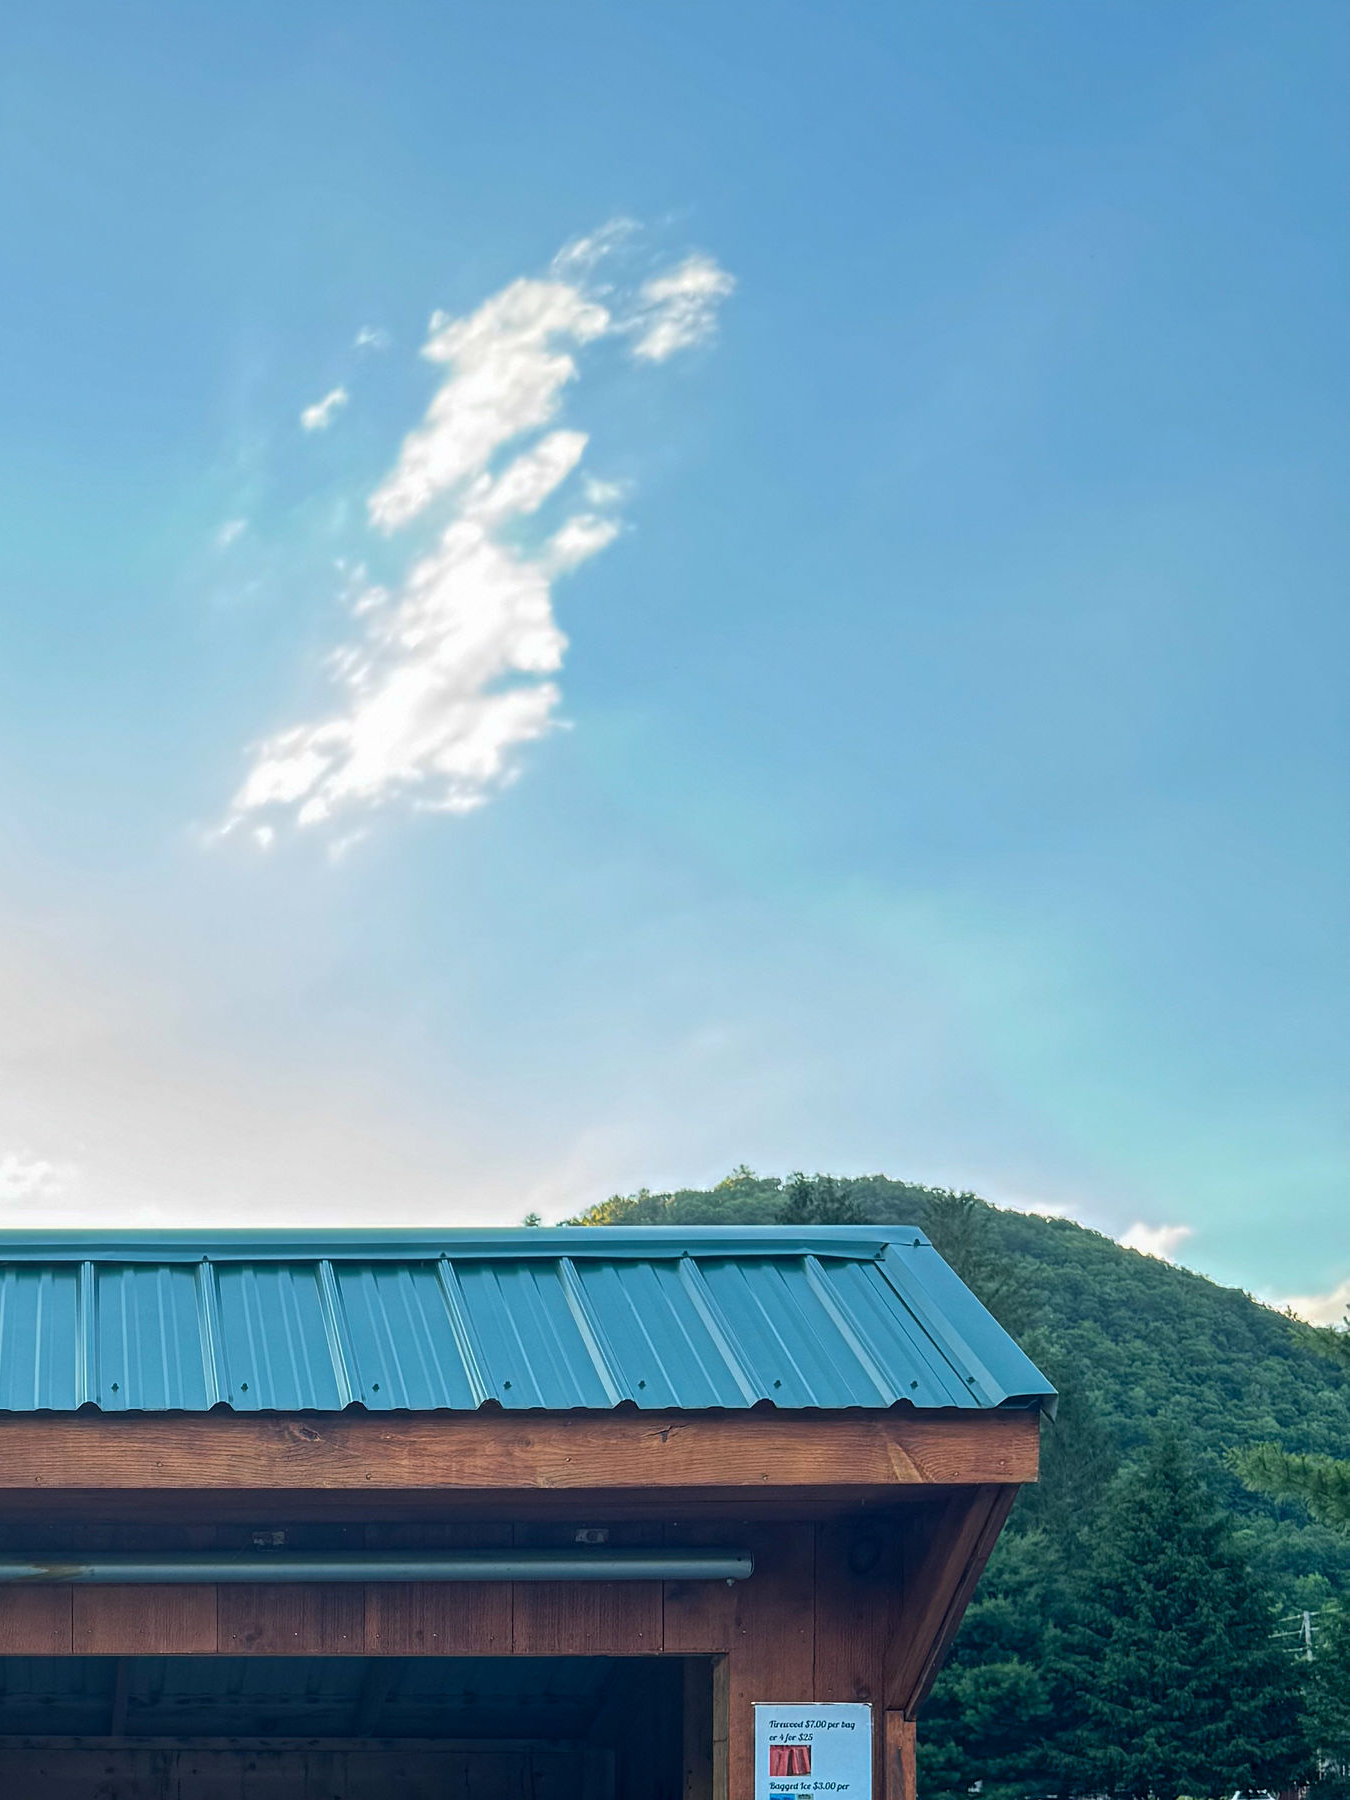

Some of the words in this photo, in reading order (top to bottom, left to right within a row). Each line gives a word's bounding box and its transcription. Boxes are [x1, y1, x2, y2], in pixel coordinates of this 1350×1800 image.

[805, 1719, 827, 1729] $7.00
[827, 1722, 840, 1730] per
[841, 1720, 856, 1730] bag
[779, 1733, 784, 1741] 4
[784, 1733, 797, 1743] for
[798, 1733, 813, 1741] $25
[769, 1782, 799, 1792] Bagged
[800, 1782, 812, 1790] Ice
[812, 1781, 836, 1790] $3.00
[836, 1784, 850, 1792] per
